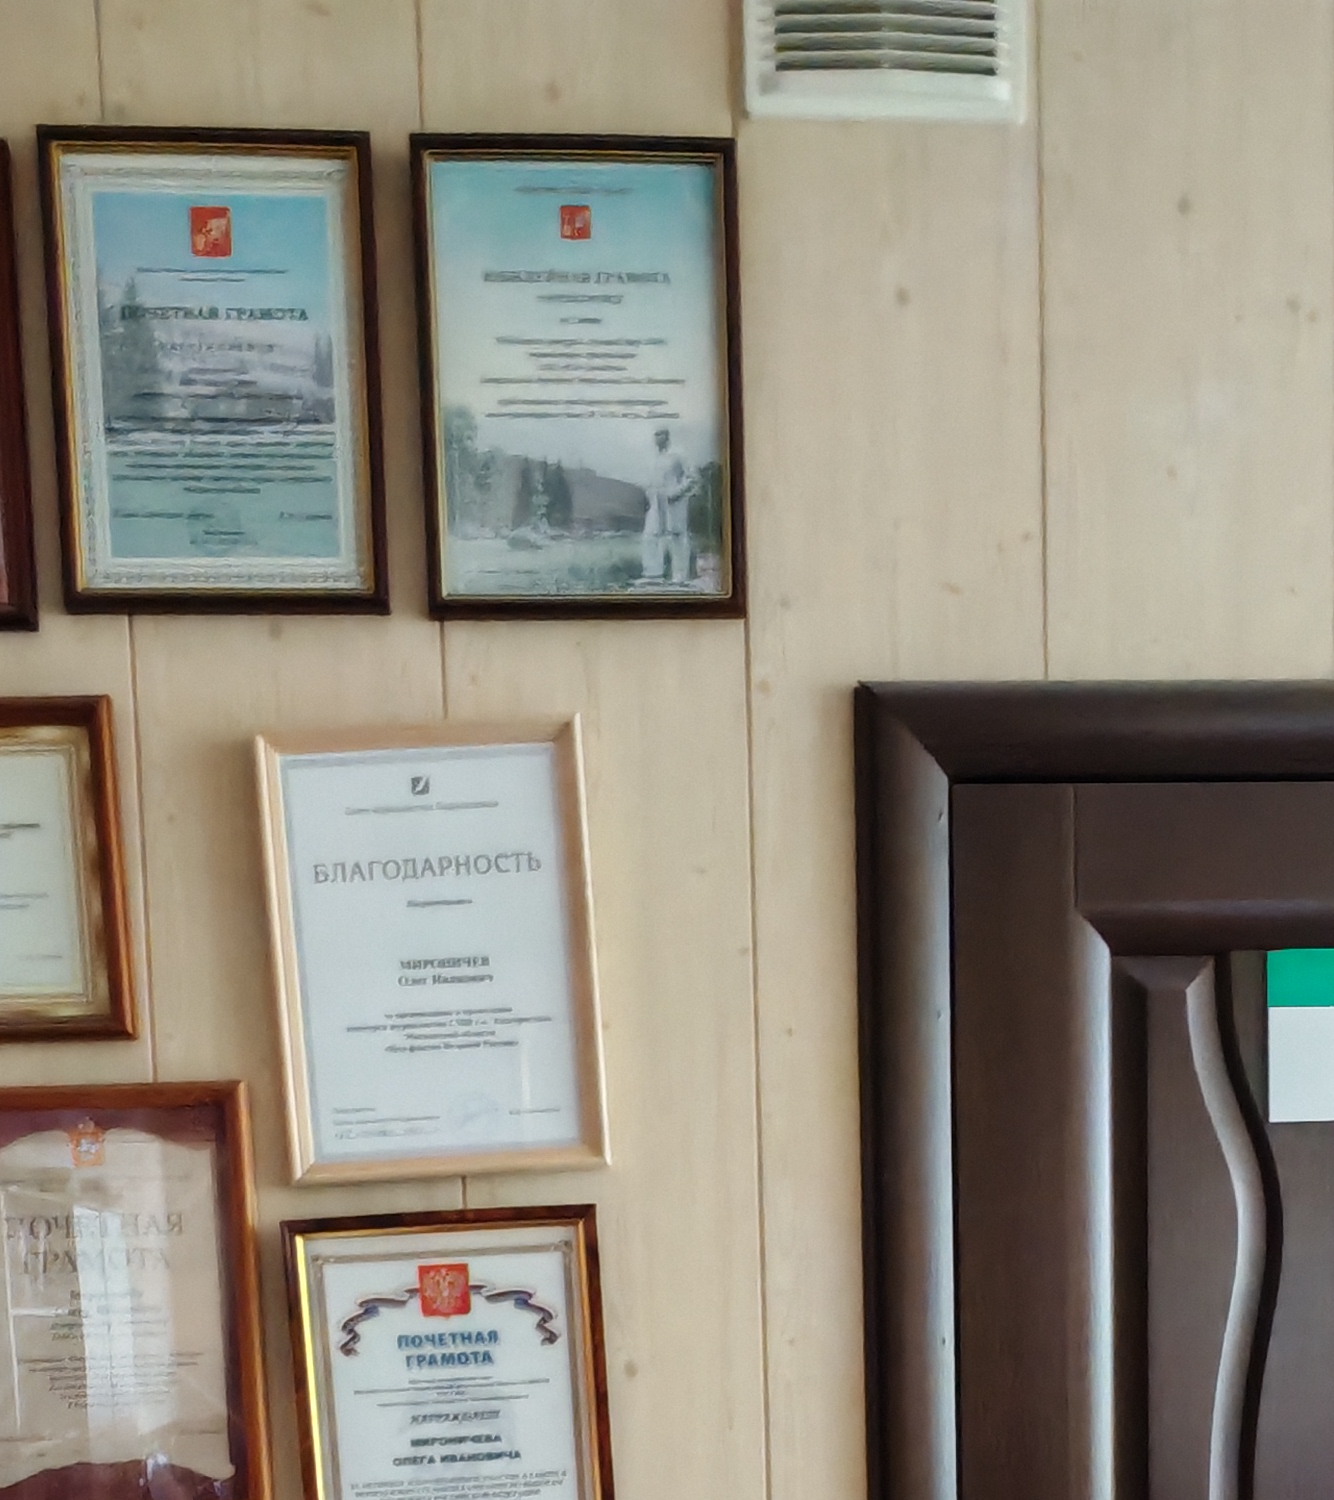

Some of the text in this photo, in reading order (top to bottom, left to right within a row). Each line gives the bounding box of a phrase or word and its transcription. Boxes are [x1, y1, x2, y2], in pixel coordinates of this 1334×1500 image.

[313, 851, 542, 884] БЛАГОДАРНОСТЬ
[397, 1330, 500, 1350] ПОЧЕТНАЯ
[405, 1350, 495, 1368] ГРАМОТА
[392, 1455, 436, 1468] ОЛЕГА
